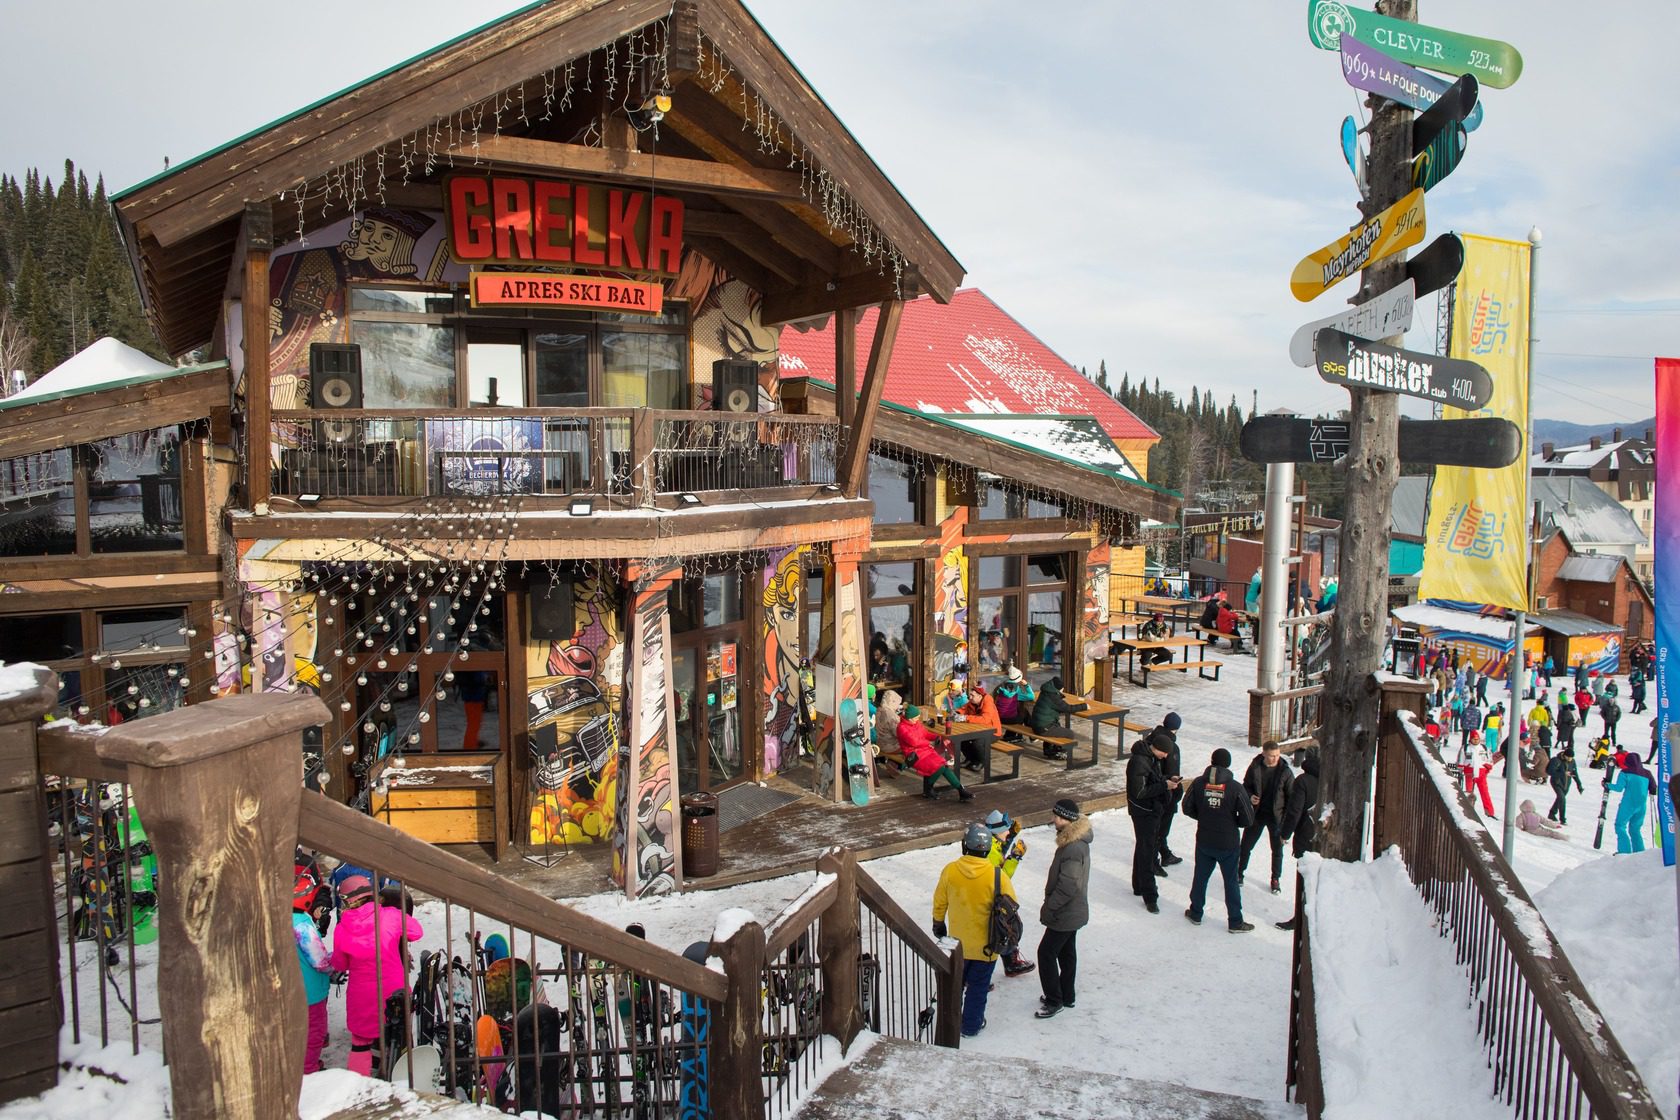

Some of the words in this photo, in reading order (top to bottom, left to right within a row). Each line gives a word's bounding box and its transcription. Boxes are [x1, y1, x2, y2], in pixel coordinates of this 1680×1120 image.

[1374, 28, 1446, 60] CLEVER
[1342, 51, 1368, 81] 1969
[1379, 67, 1392, 84] LA
[1393, 75, 1418, 96] FOLIE
[450, 176, 685, 273] GRELKA
[1323, 219, 1381, 287] Mayrhofen
[501, 280, 563, 300] APRES
[569, 283, 601, 302] SKI
[608, 286, 646, 306] BAR
[1348, 341, 1433, 394] bunker
[1431, 387, 1447, 399] club
[1208, 522, 1219, 533] BAR
[1221, 516, 1251, 535] ZUBR
[1208, 797, 1221, 806] 151
[862, 967, 870, 1002] HEAD
